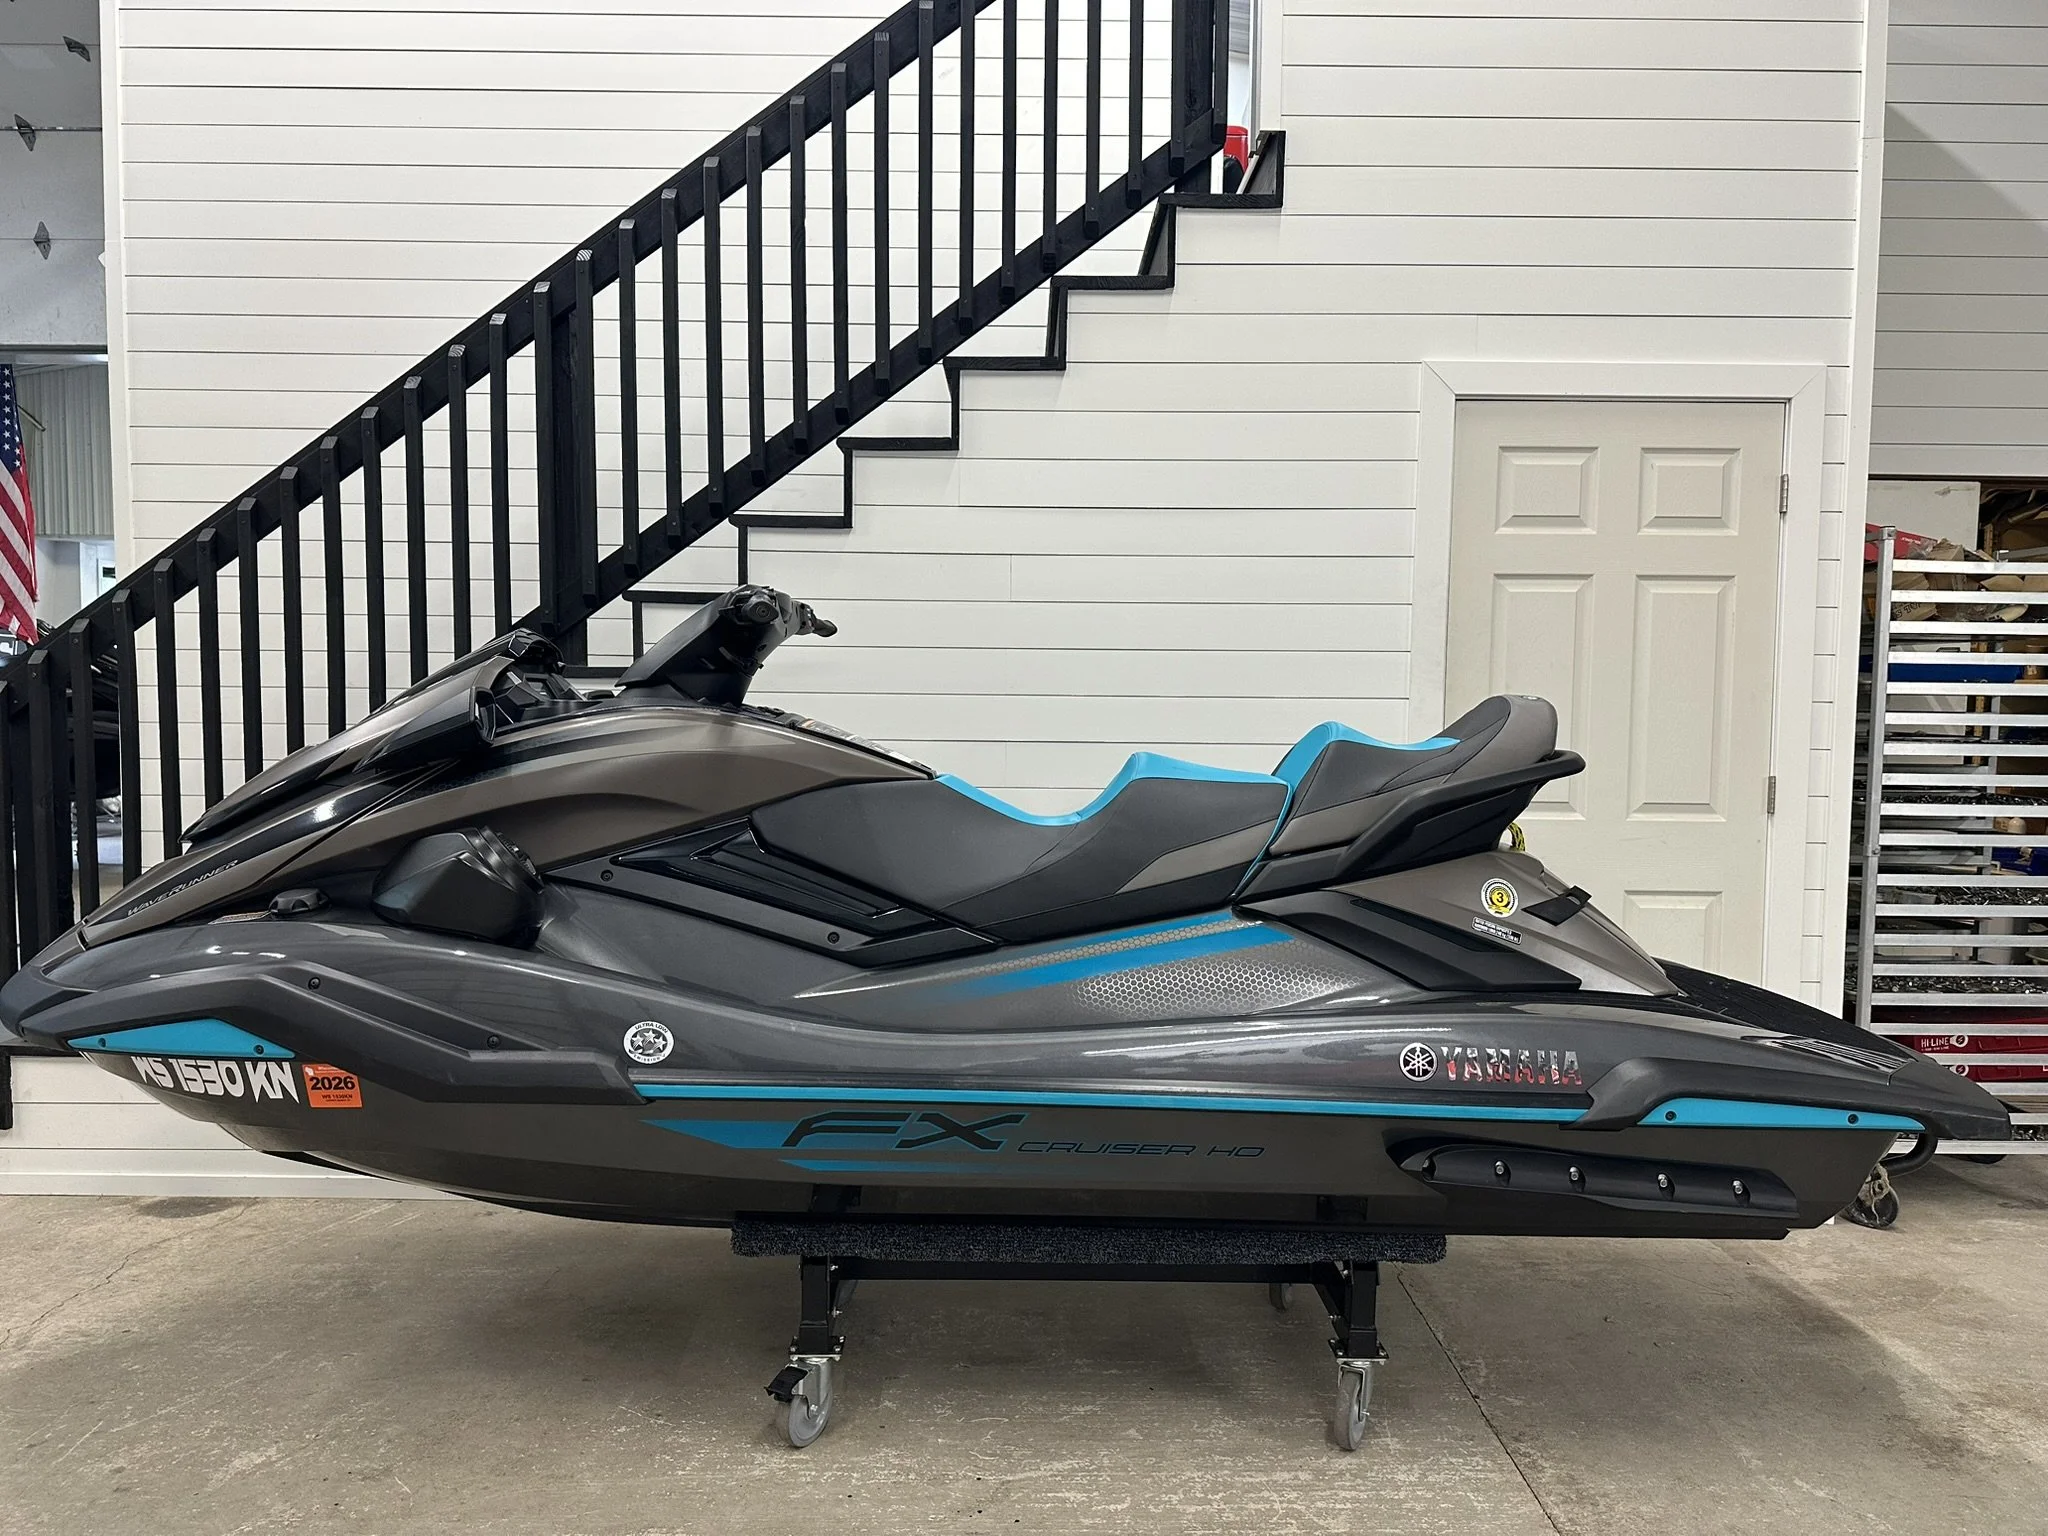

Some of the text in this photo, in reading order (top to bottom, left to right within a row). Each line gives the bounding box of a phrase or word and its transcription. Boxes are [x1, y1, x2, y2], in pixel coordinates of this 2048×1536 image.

[1496, 892, 1504, 903] 3
[130, 1056, 300, 1104] WS 1530 KN
[309, 1076, 356, 1090] 2026
[1440, 1046, 1583, 1085] YAMAHA
[780, 1111, 1267, 1159] FX CRUISER HO
